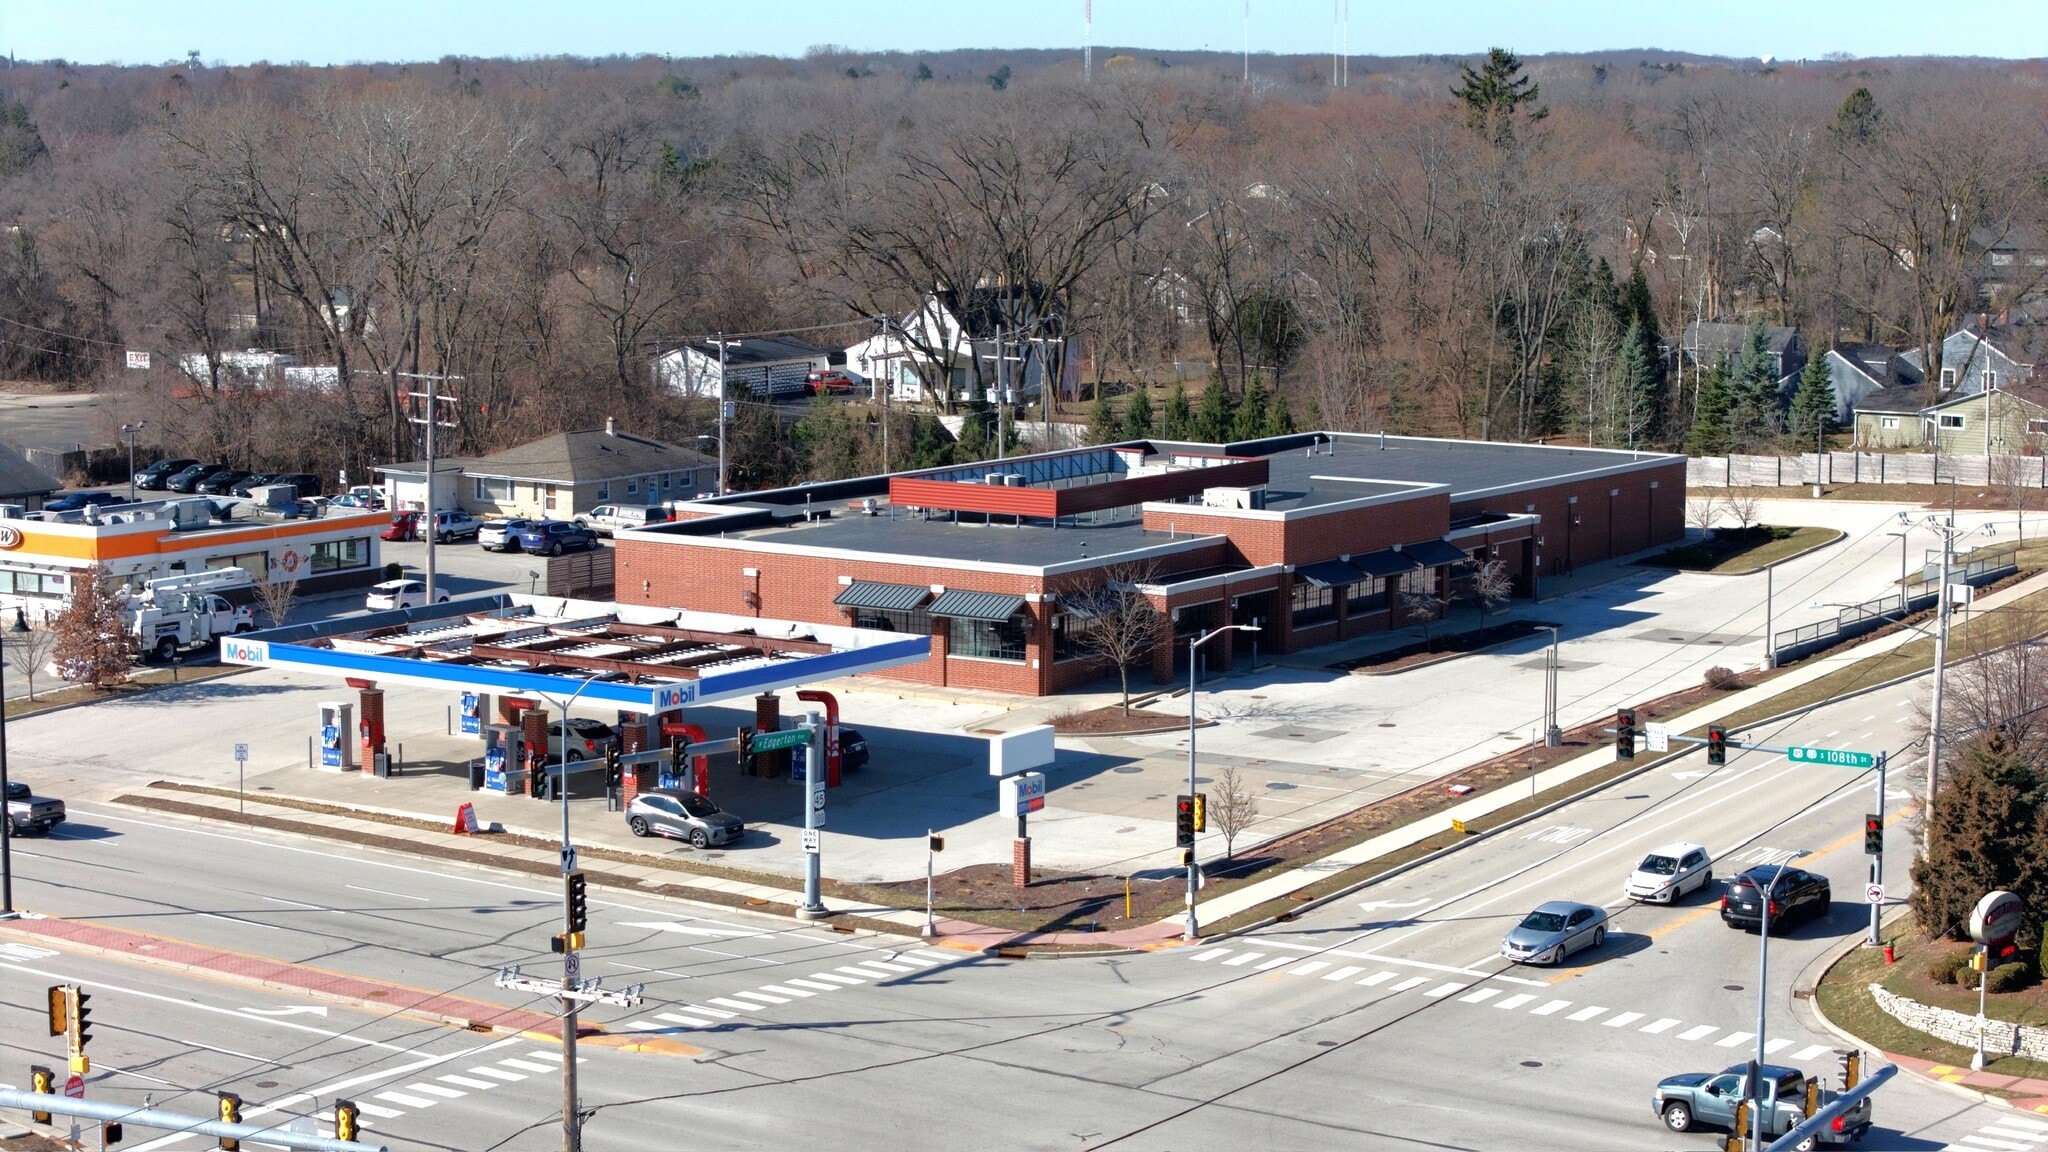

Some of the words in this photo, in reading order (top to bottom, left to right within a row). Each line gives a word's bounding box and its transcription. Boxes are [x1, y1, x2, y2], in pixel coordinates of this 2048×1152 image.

[129, 353, 148, 362] EXIT
[226, 643, 263, 662] Mobil
[660, 685, 695, 707] Mobil
[763, 734, 796, 749] Edgerton
[1827, 750, 1858, 764] 108th
[1019, 780, 1043, 797] Mobil
